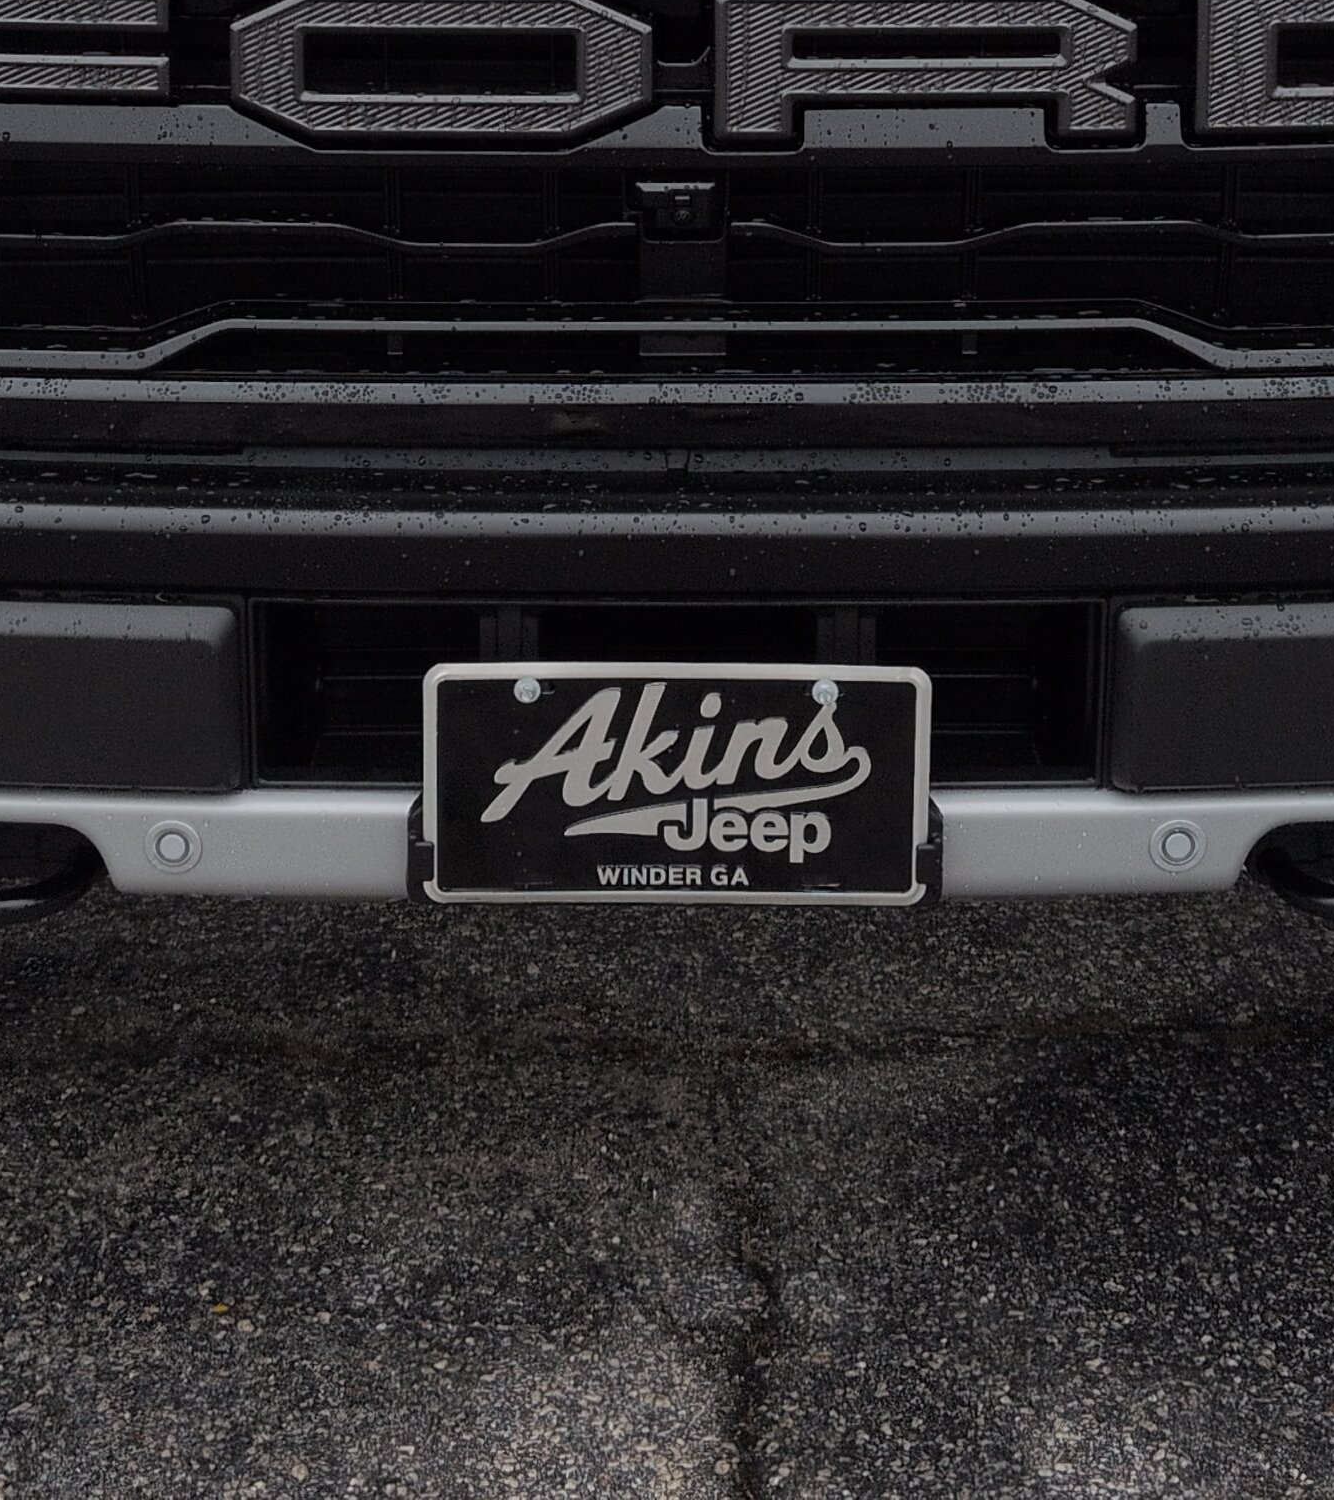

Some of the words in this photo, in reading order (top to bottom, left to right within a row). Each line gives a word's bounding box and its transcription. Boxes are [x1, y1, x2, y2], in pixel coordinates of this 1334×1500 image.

[479, 681, 872, 823] Akins
[662, 798, 832, 864] Jeep
[596, 864, 702, 887] WINDER
[710, 864, 750, 887] GA
